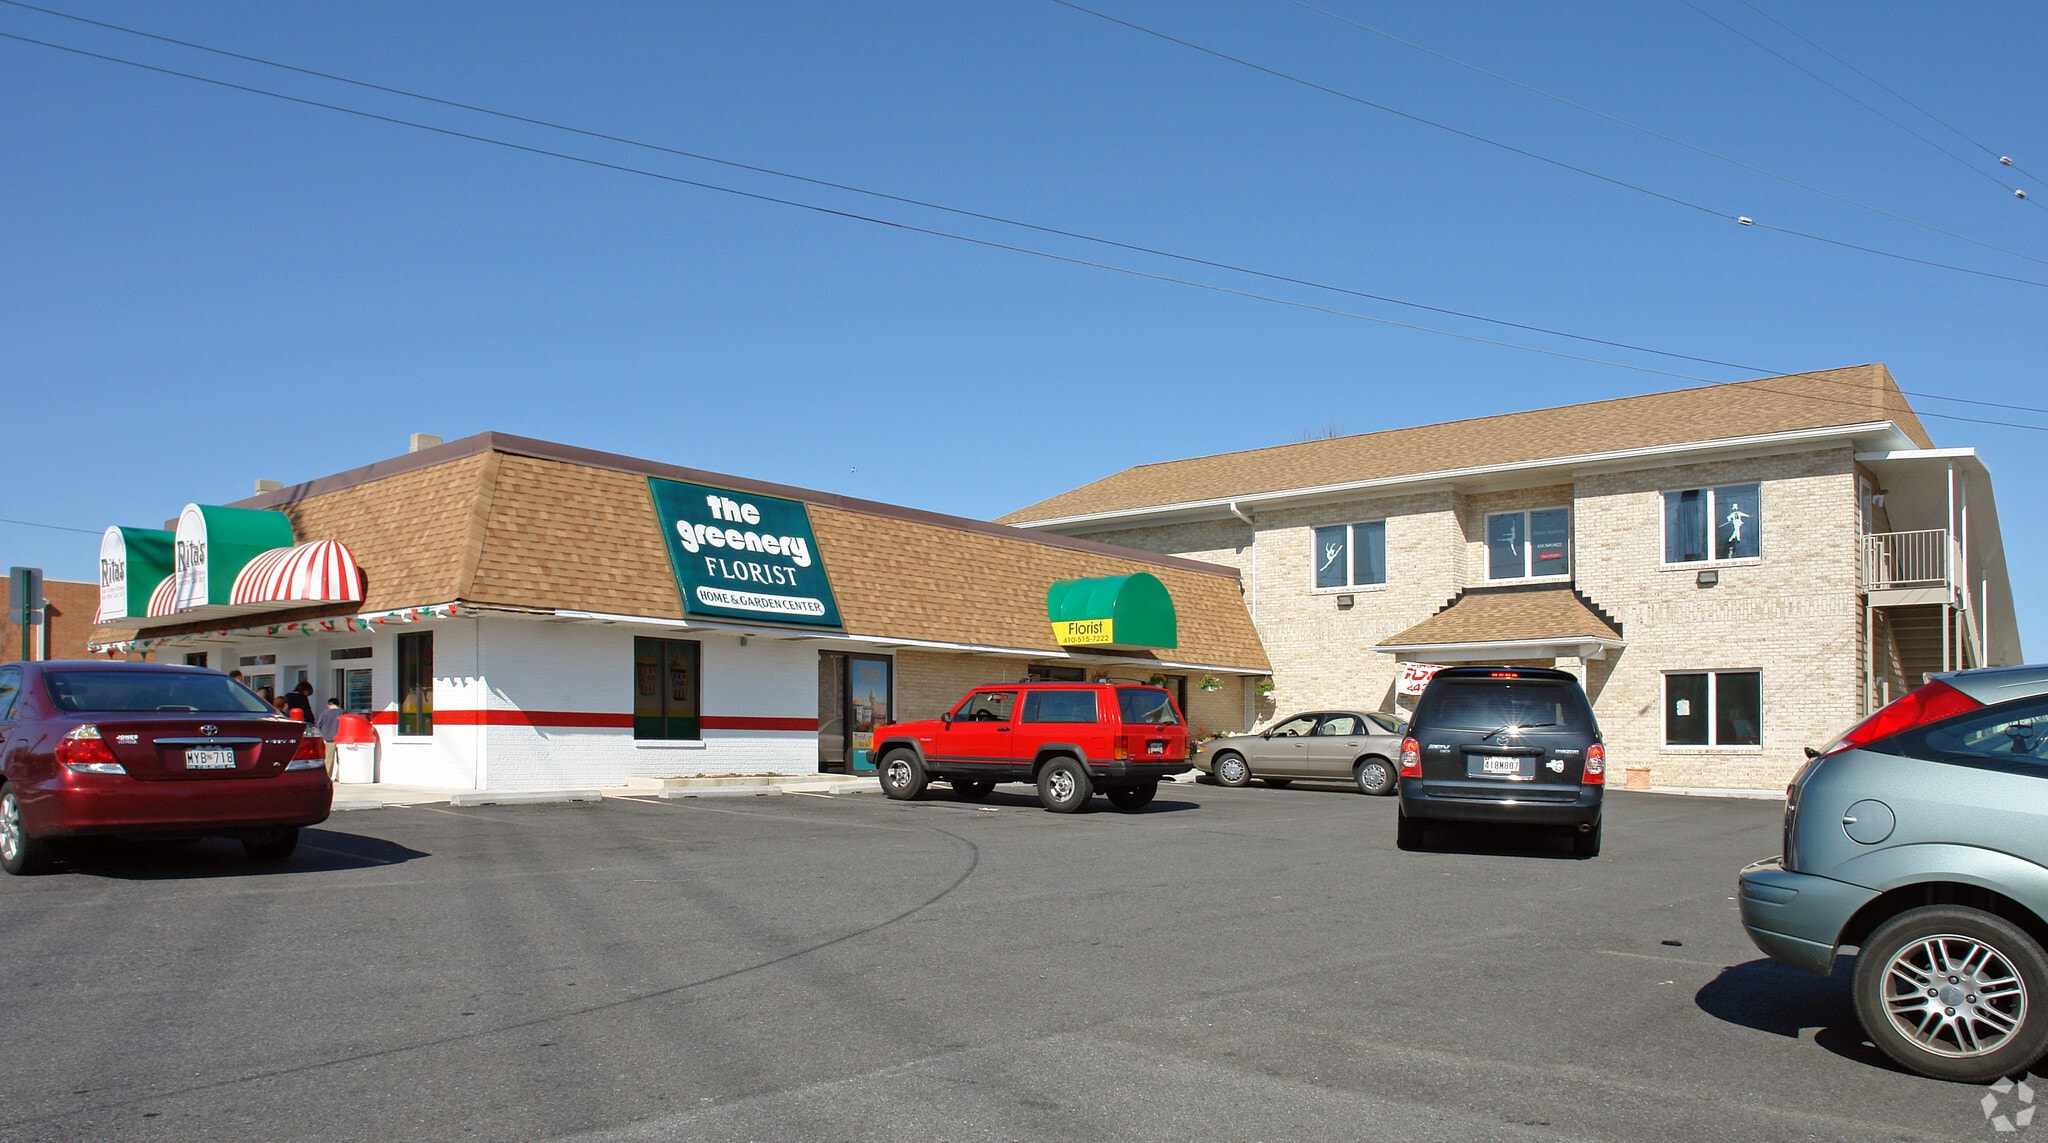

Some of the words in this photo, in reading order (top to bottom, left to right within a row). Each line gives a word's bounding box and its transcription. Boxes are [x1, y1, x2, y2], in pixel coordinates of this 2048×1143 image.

[706, 494, 760, 525] the
[177, 540, 205, 573] Rita's
[676, 520, 811, 567] greenery
[101, 559, 124, 588] Rita's
[704, 556, 798, 586] FLORIST
[699, 590, 730, 604] HOME
[730, 594, 740, 605] &
[740, 595, 782, 609] GARDEN
[782, 600, 823, 613] CENTER
[1063, 635, 1109, 644] 410-515-7222
[1068, 621, 1103, 635] Florist
[213, 752, 233, 763] 718
